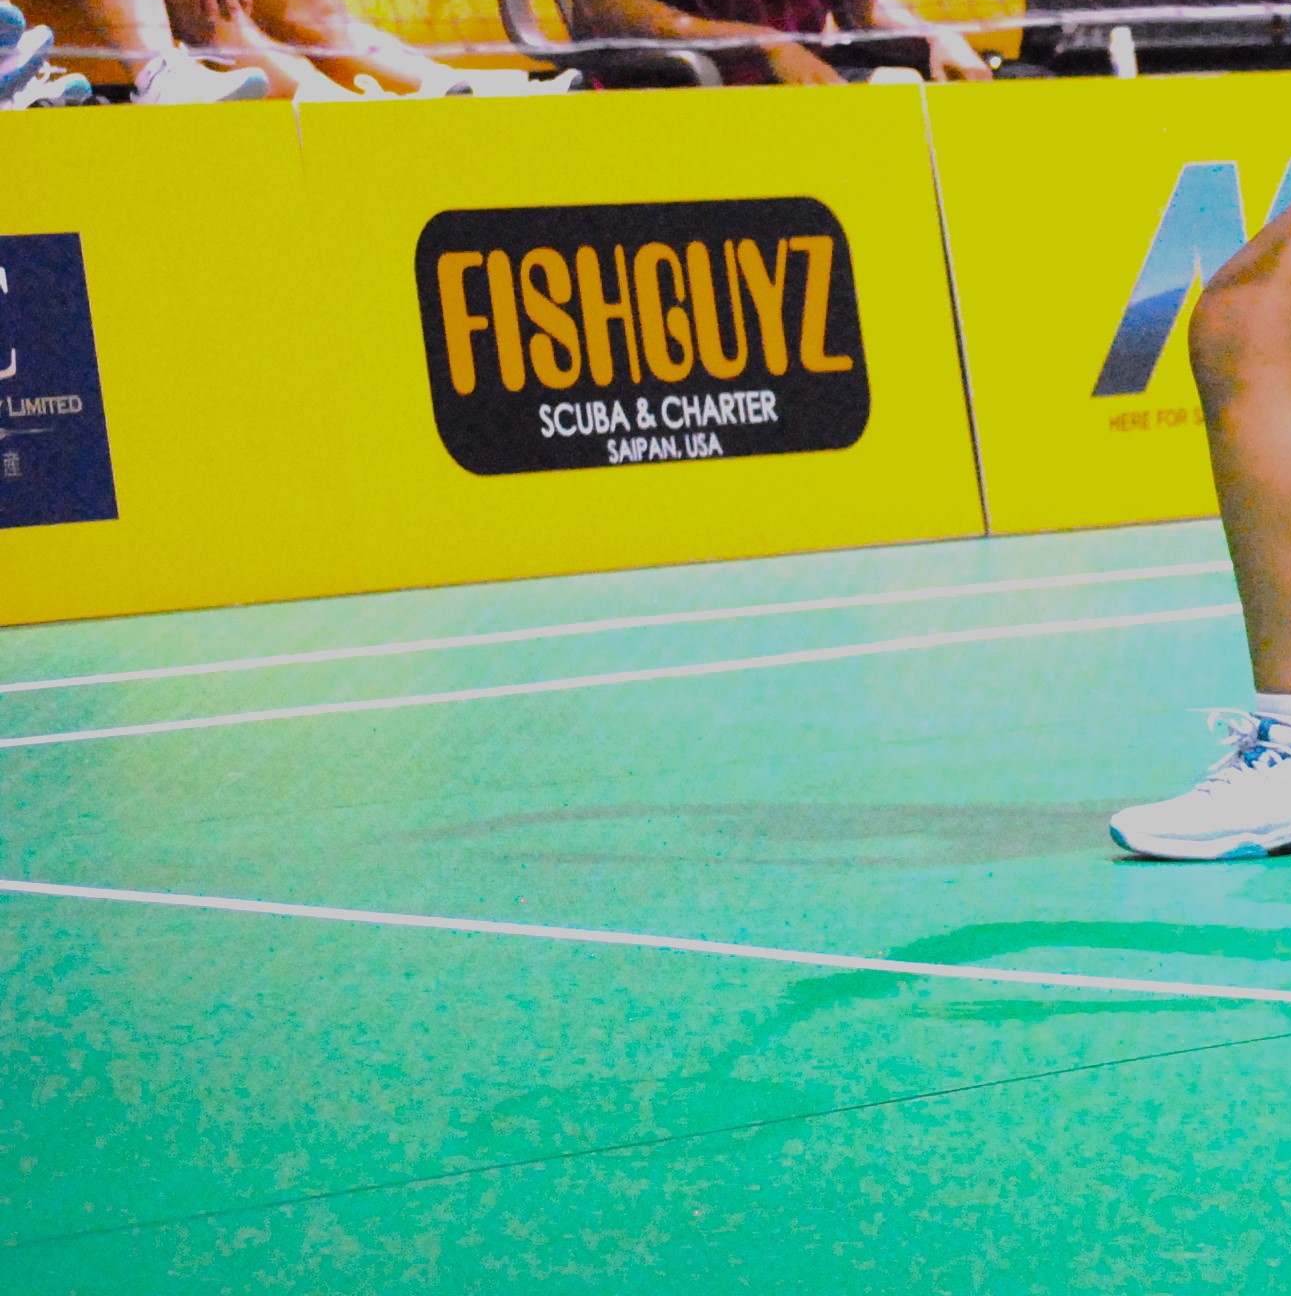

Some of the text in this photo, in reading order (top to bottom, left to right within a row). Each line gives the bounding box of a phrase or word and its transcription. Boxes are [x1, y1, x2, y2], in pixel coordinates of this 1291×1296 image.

[436, 234, 854, 396] FISHGUYZ
[8, 394, 83, 418] LIMITED
[538, 388, 780, 439] SCUBA & CHARTER
[606, 431, 724, 464] SAIPAN, USA
